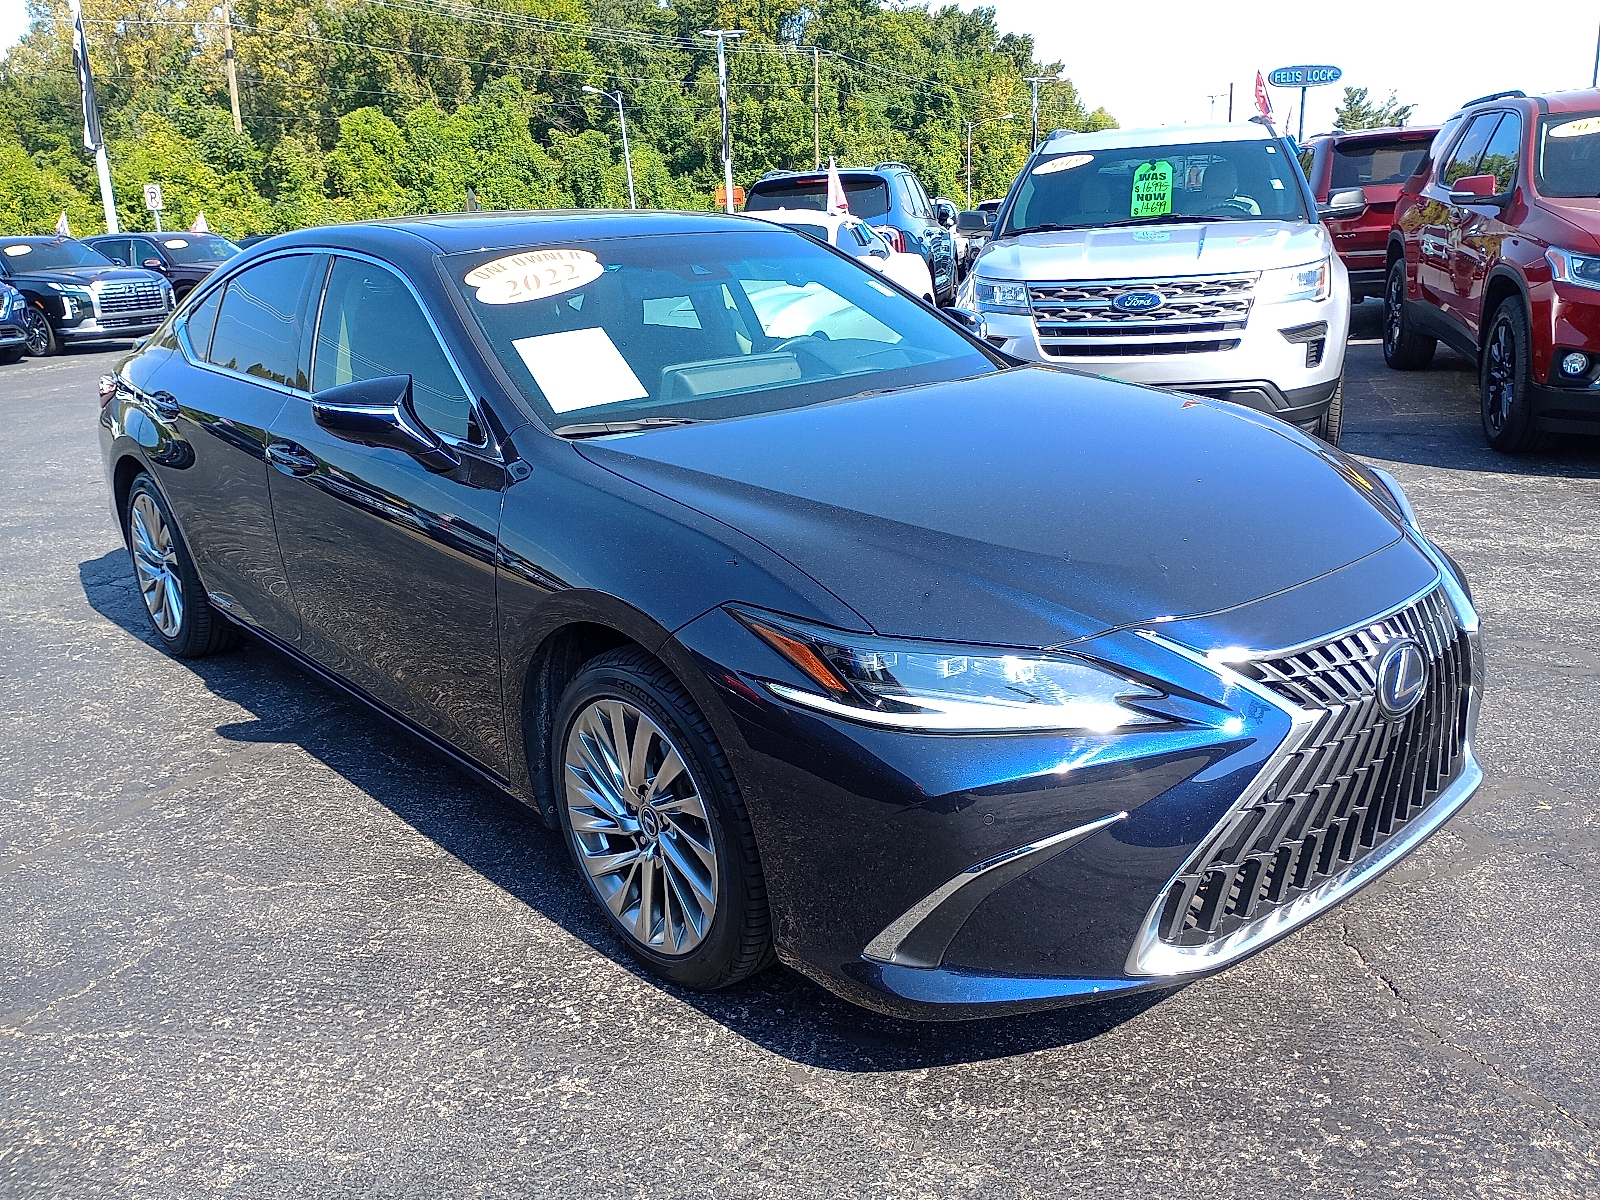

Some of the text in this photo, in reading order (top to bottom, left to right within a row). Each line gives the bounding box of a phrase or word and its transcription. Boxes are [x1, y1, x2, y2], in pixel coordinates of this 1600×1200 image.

[1274, 71, 1302, 83] FELTS
[1139, 172, 1167, 181] WAS
[1136, 192, 1167, 201] NOW
[512, 251, 581, 267] OWNER
[505, 264, 580, 299] 2022
[1124, 295, 1153, 307] Ford
[616, 680, 677, 730] CONQUEST
